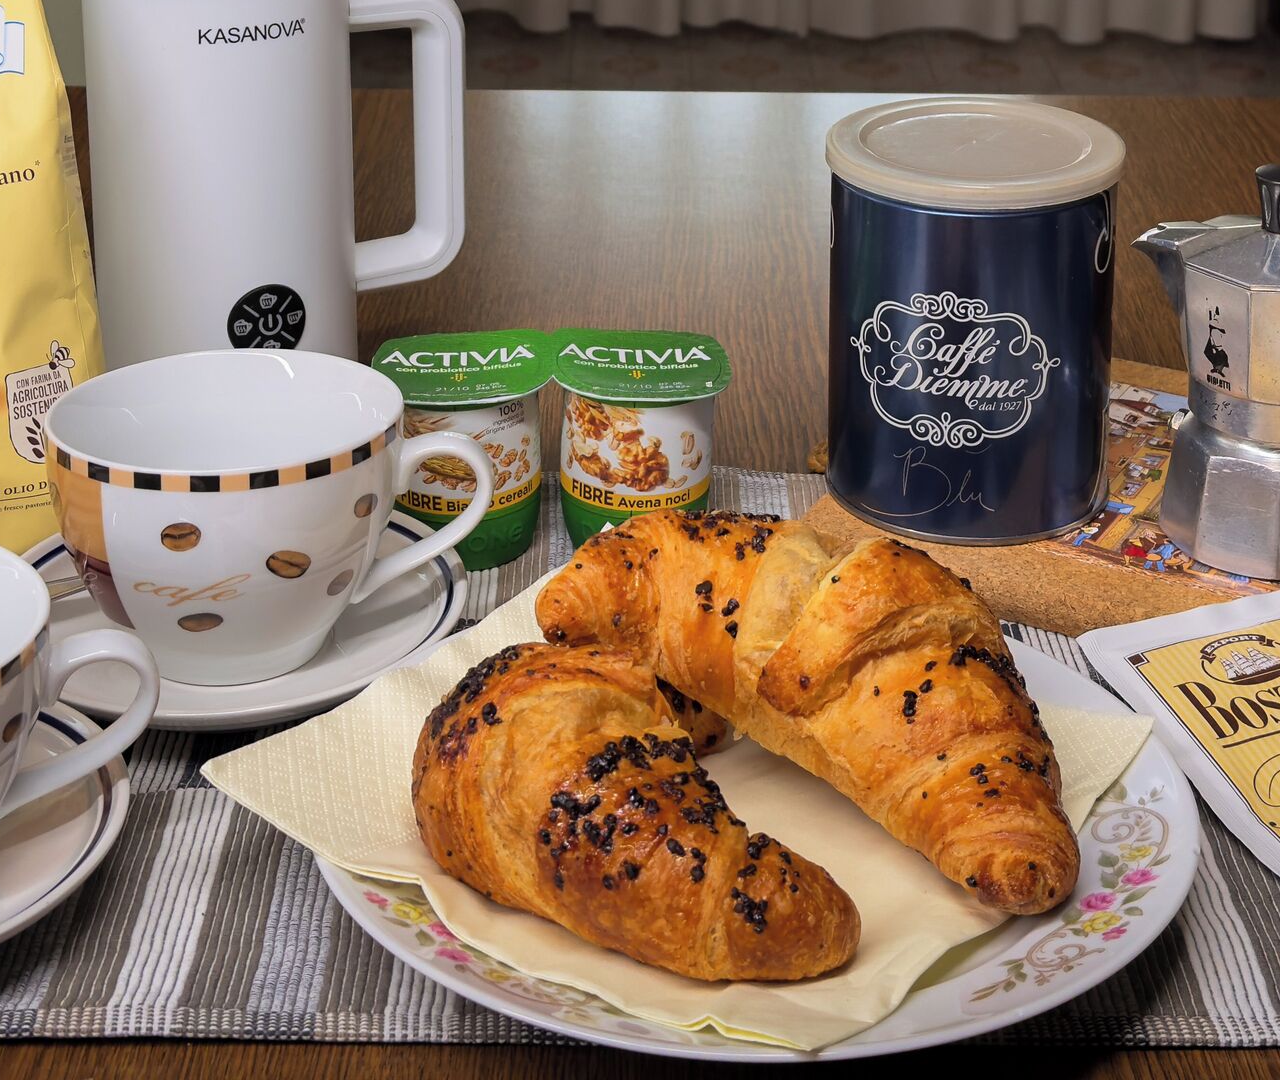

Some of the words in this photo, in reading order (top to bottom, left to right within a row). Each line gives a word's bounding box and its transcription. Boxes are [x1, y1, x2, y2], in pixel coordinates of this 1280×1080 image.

[197, 19, 305, 45] KASANOVA
[381, 344, 536, 367] ACTIVIA
[558, 343, 712, 364] ACTIVIA
[16, 379, 30, 389] CON
[31, 373, 52, 386] FARINA
[53, 370, 62, 380] DA
[874, 353, 1026, 410] Diemme
[12, 380, 69, 405] AGRICOLTURA
[13, 396, 61, 420] SOSTENI
[978, 401, 996, 411] dal
[999, 400, 1022, 411] 1927
[4, 483, 35, 496] OLIO
[39, 481, 48, 490] D
[447, 500, 495, 512] Biao
[498, 480, 533, 505] cereali
[571, 478, 615, 508] FIBRE
[618, 493, 662, 508] Avena
[665, 489, 691, 505] noci
[25, 501, 52, 510] pastoriz
[1204, 635, 1260, 653] EXPORT
